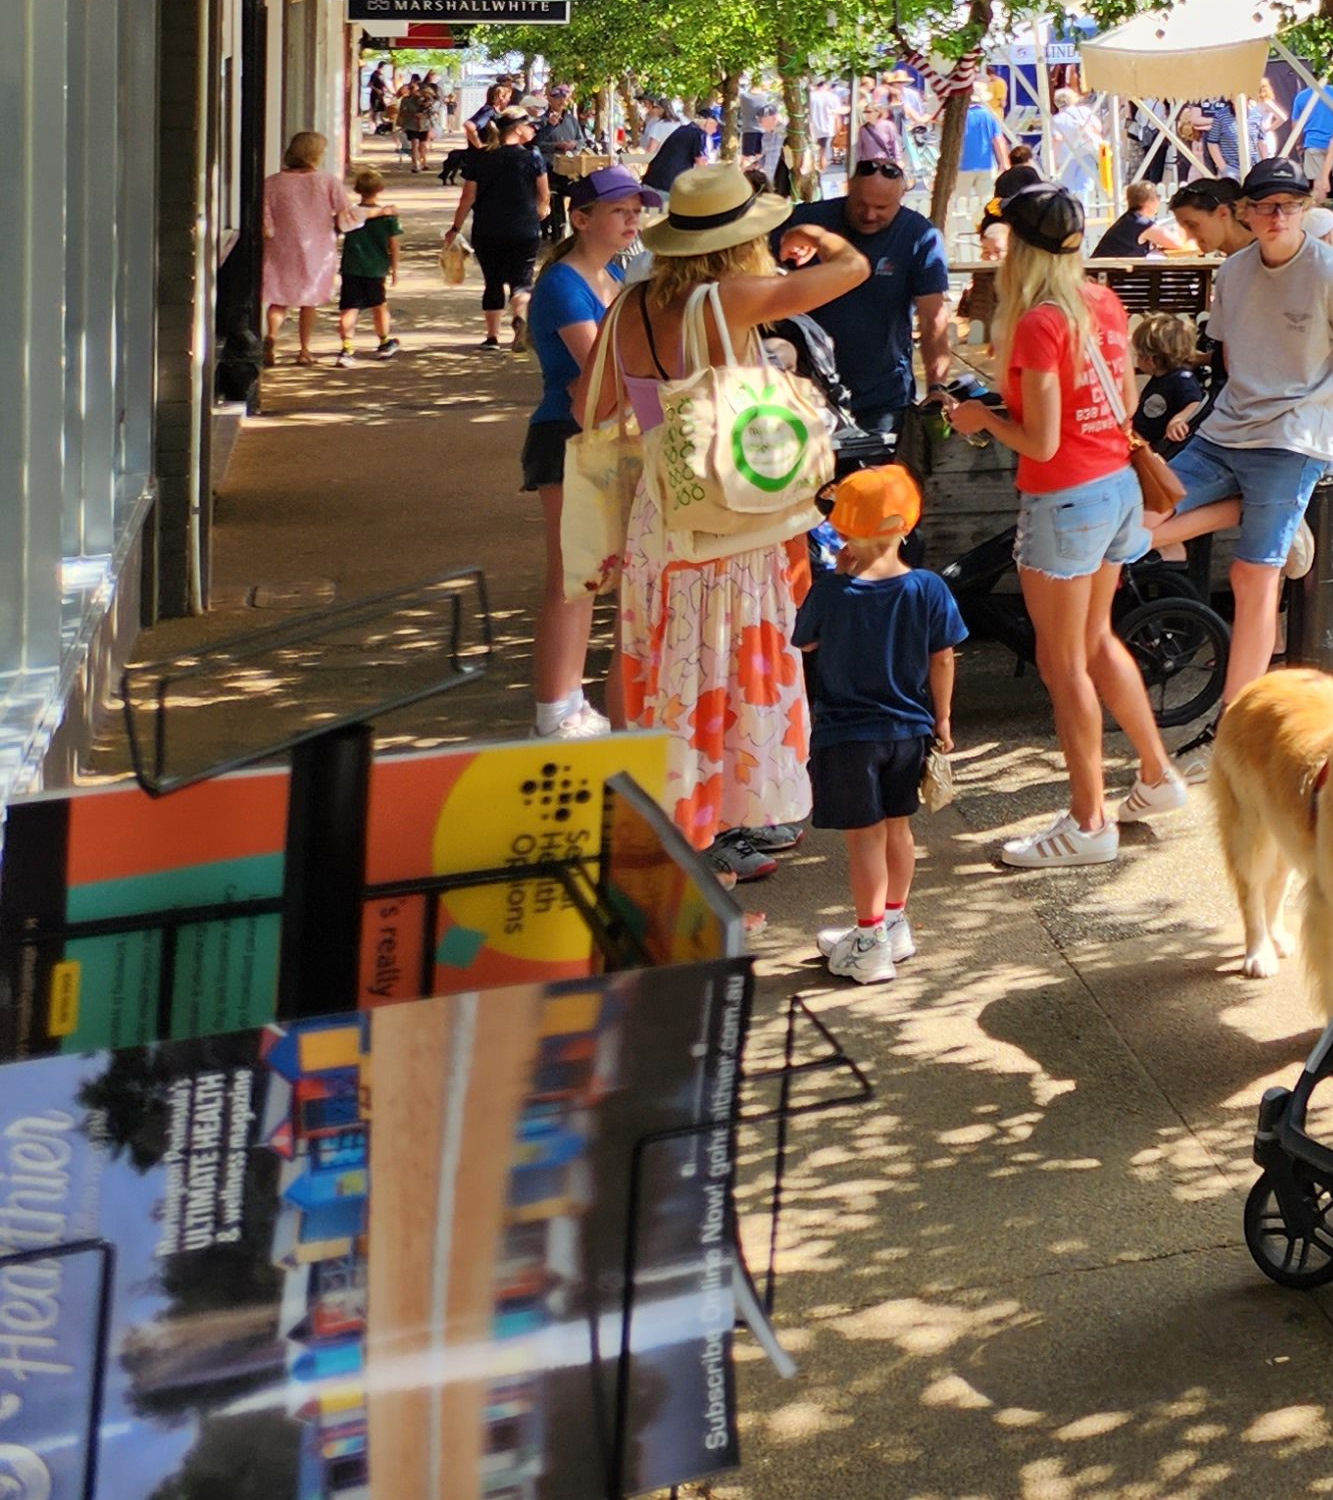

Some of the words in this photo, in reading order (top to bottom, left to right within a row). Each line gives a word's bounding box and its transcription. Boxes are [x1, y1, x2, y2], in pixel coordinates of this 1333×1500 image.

[503, 833, 538, 936] Opions
[533, 831, 564, 914] Helth
[368, 927, 400, 998] really
[191, 1073, 226, 1149] HEALTH
[227, 1069, 256, 1149] magazine
[184, 1150, 219, 1250] ULTIMATE
[219, 1150, 247, 1224] wellness
[702, 1182, 726, 1242] Now!
[0, 1108, 76, 1382] Heathier
[216, 1227, 242, 1243] &
